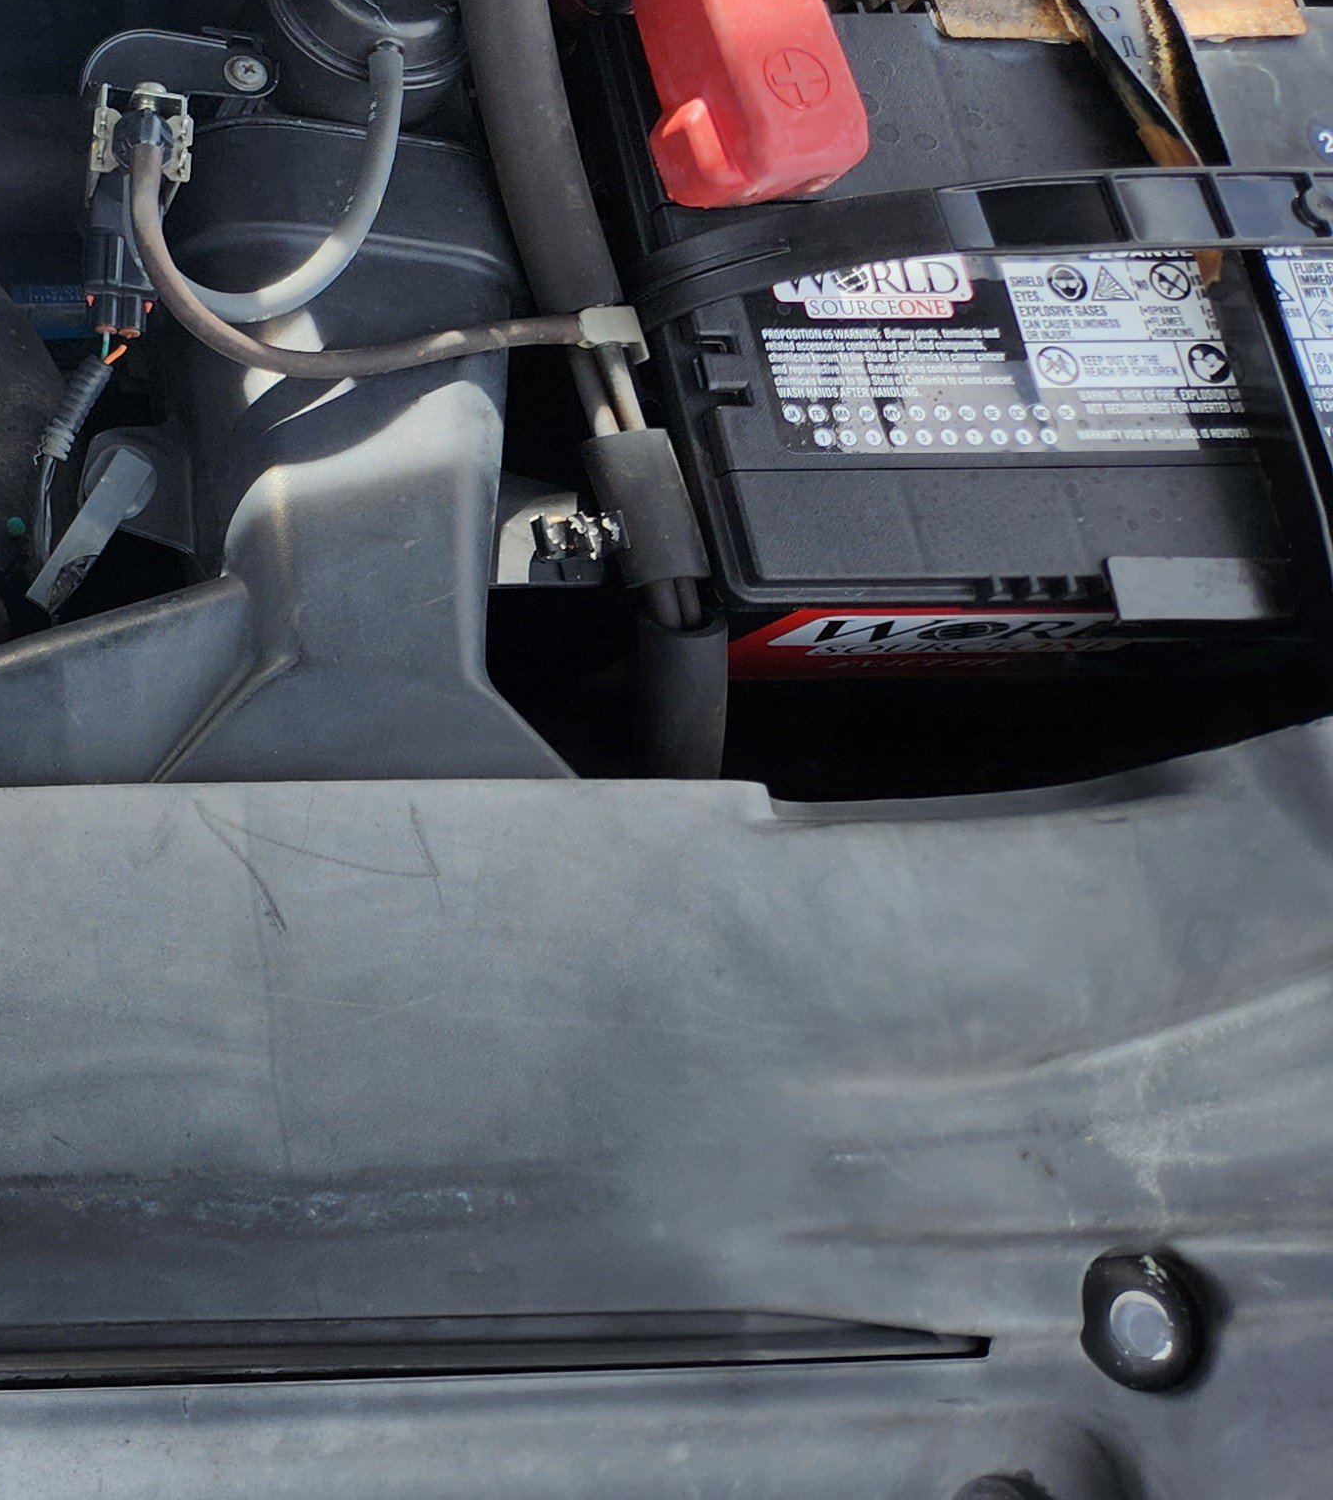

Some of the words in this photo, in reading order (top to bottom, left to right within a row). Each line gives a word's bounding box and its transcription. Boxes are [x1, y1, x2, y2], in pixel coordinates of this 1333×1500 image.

[1009, 275, 1044, 287] SHIELD
[809, 300, 948, 316] SOURCEONE
[1018, 305, 1073, 317] EXPLOSIVE
[1074, 305, 1108, 317] GASES
[1022, 319, 1041, 329] CAN
[1042, 319, 1071, 329] CAUSE
[1073, 319, 1121, 329] BLINDNESS
[761, 327, 822, 340] PROPOSITION
[795, 341, 845, 351] accessories
[845, 341, 877, 351] contain
[864, 352, 888, 363] State
[898, 351, 940, 362] California
[1081, 355, 1103, 366] KEEP
[1106, 355, 1125, 366] OUT
[1127, 355, 1139, 365] OF
[1141, 354, 1161, 365] THE
[1084, 366, 1116, 377] REACH
[1117, 366, 1130, 377] OF
[871, 375, 894, 386] State
[776, 386, 805, 398] WASH
[805, 386, 838, 398] HANDS
[839, 386, 870, 398] AFTER
[870, 386, 922, 398] HANDLING.
